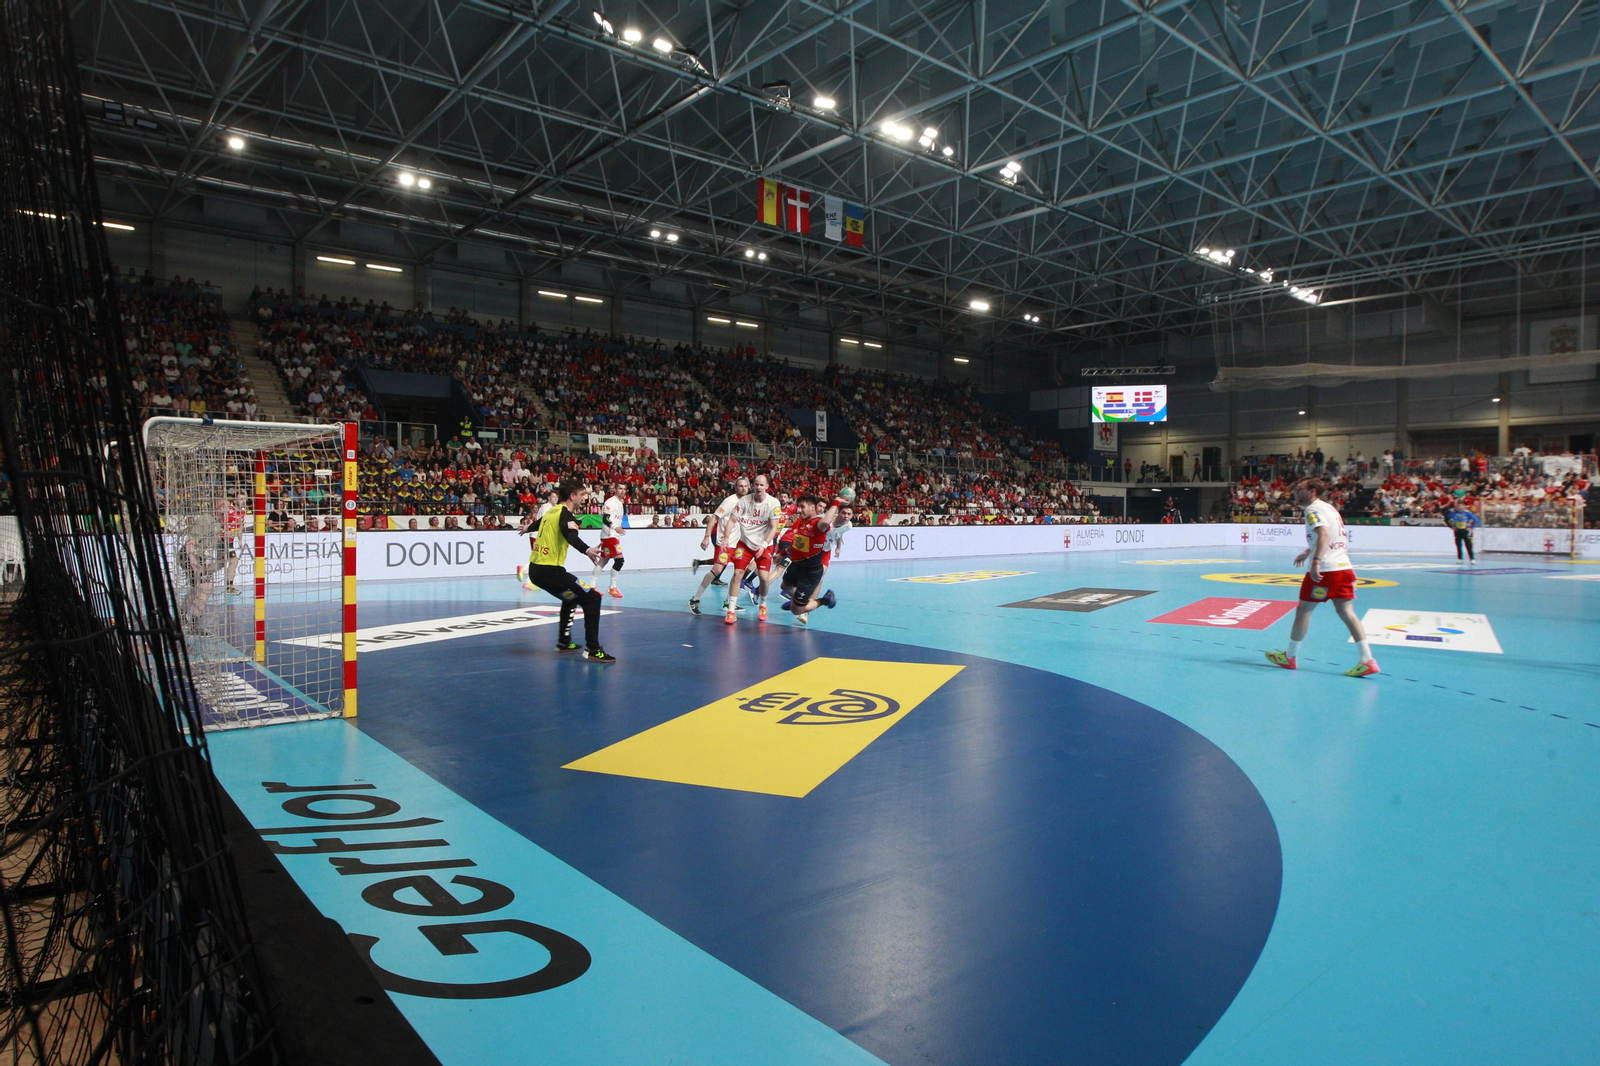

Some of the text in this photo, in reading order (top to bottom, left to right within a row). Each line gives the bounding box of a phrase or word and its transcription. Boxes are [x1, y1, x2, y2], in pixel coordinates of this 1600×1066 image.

[1077, 527, 1105, 539] ALMERÍA
[1115, 530, 1145, 544] DONDE
[1256, 526, 1293, 536] ALMERÍA
[239, 538, 343, 561] AMERÍA
[865, 533, 915, 552] DONDE
[386, 541, 485, 567] DONDE
[237, 563, 293, 575] CIDAD
[251, 781, 592, 1000] Gerflor
